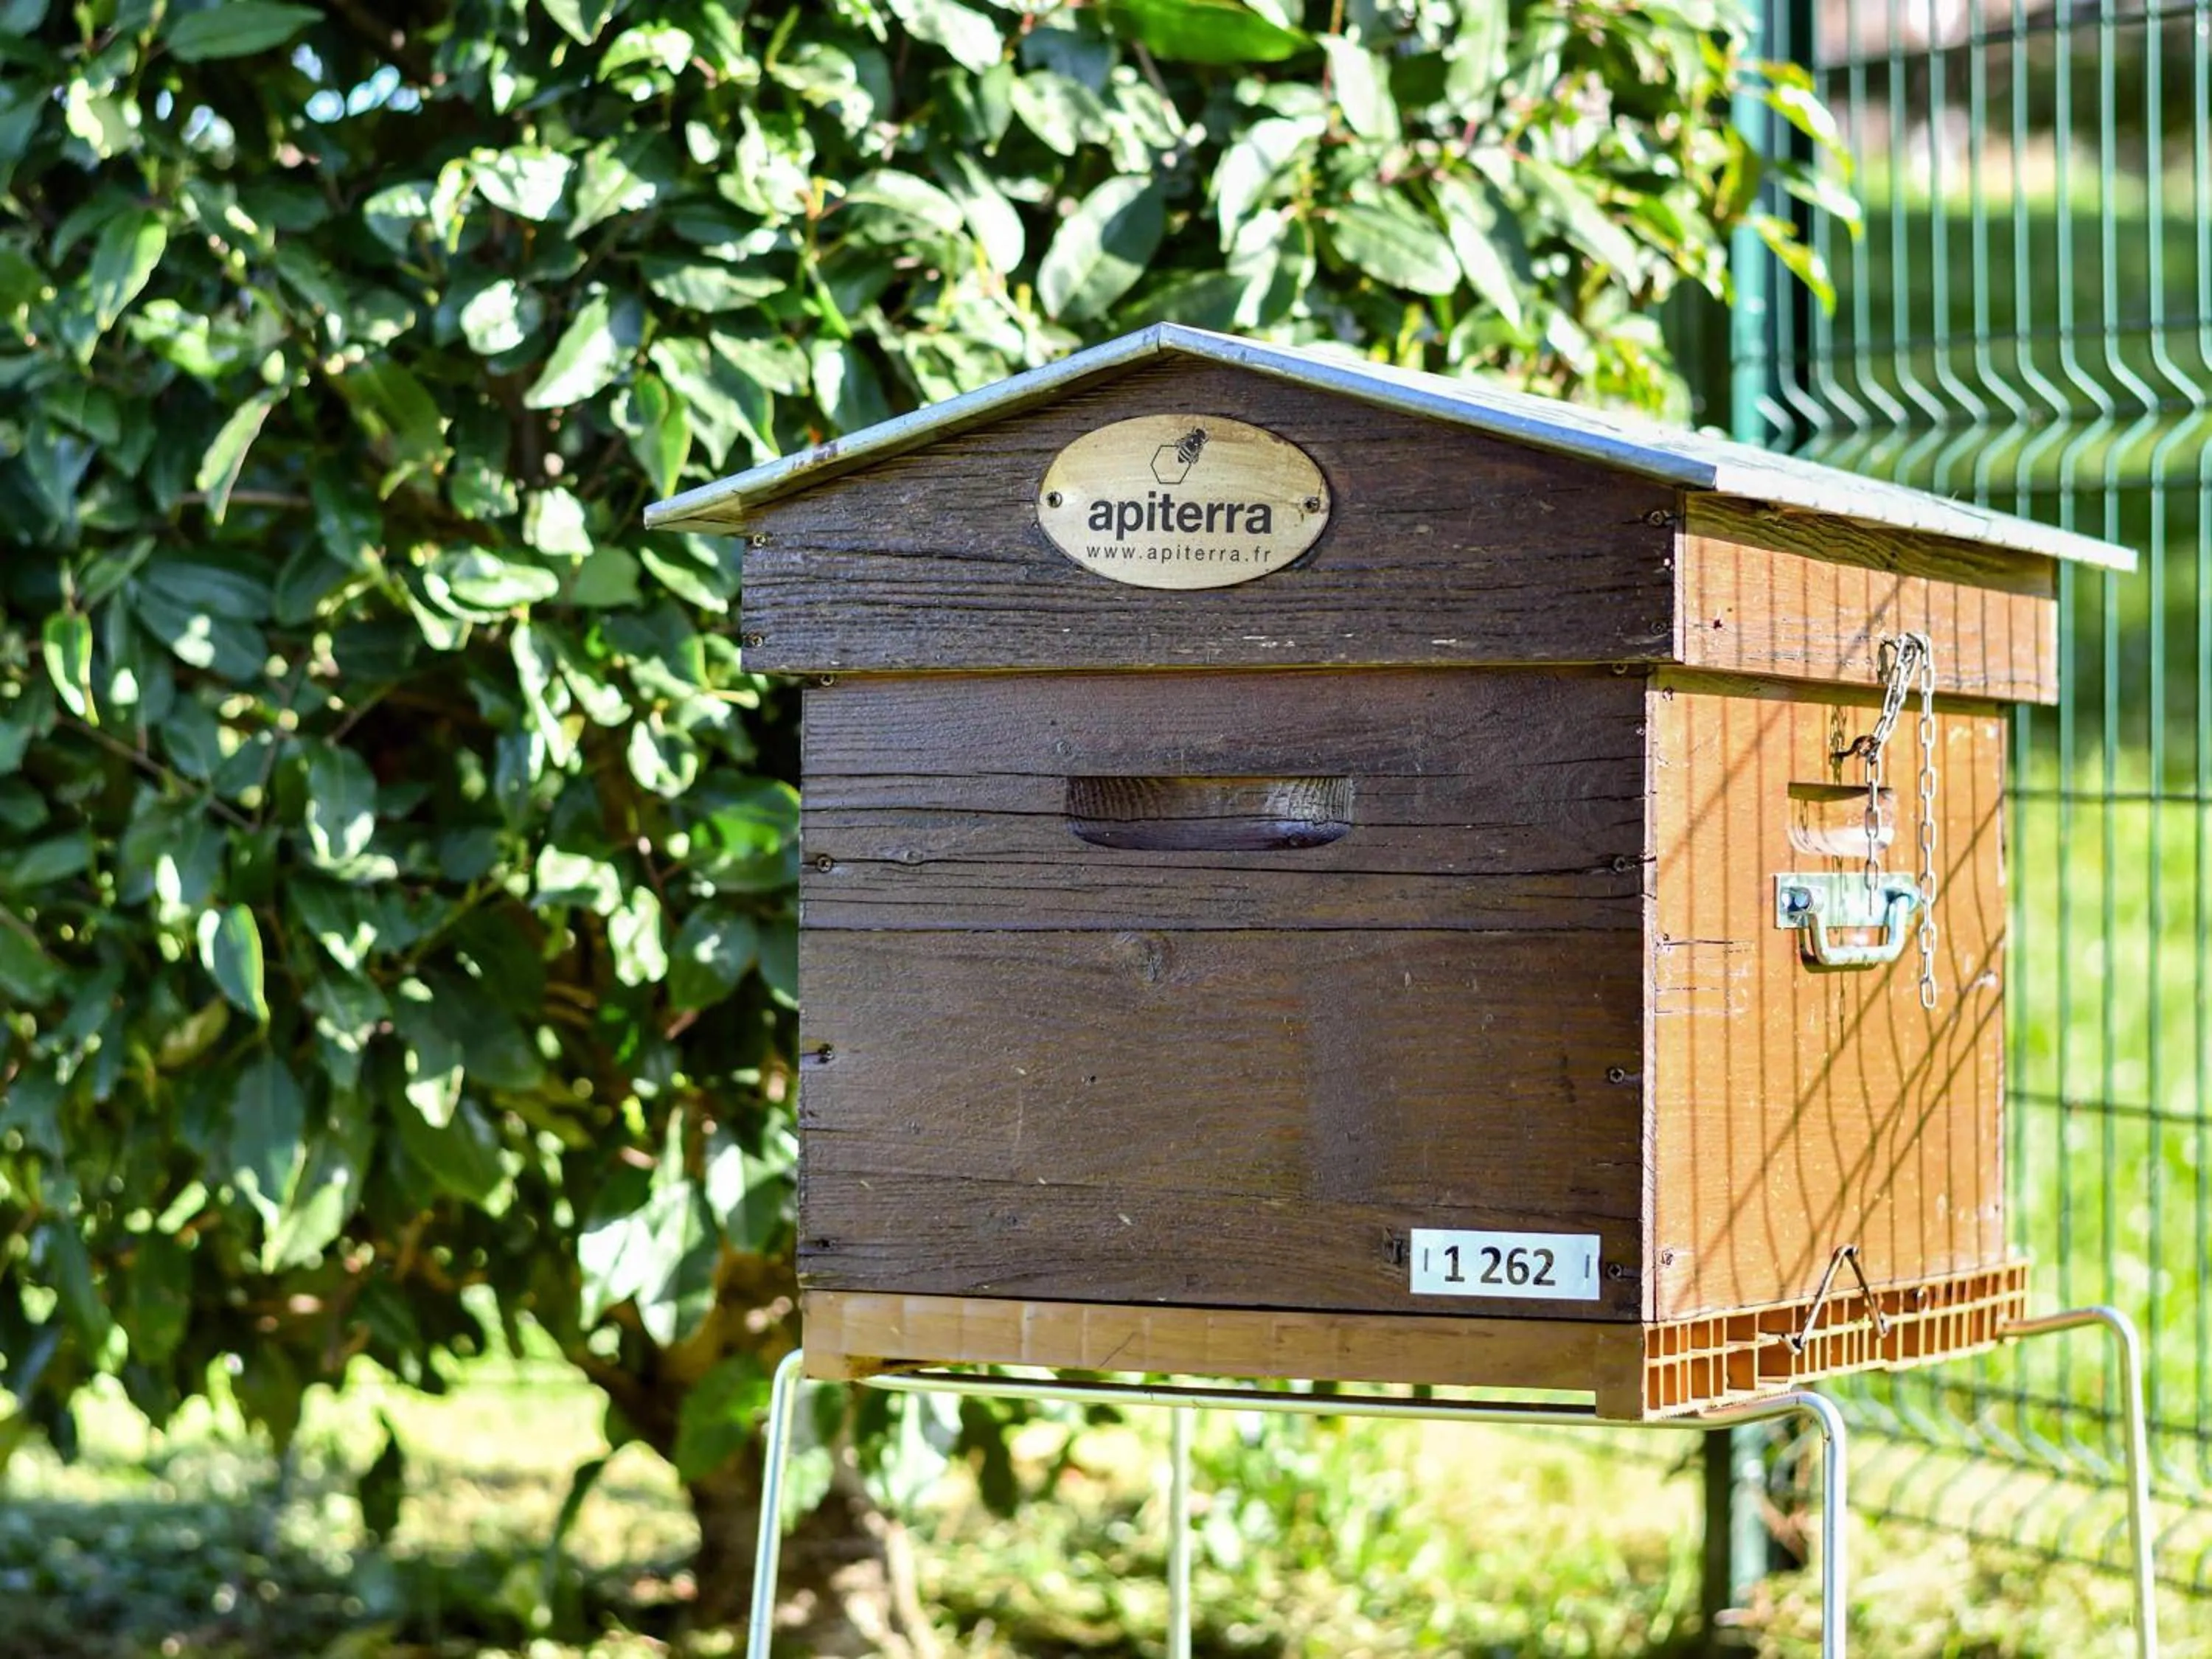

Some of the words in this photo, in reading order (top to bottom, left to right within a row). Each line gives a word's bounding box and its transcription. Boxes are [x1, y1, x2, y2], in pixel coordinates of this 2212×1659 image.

[1088, 490, 1272, 540] apiterra
[1086, 544, 1271, 563] www.apiterra.fr
[1444, 1245, 1465, 1282] 1
[1480, 1246, 1556, 1286] 262
